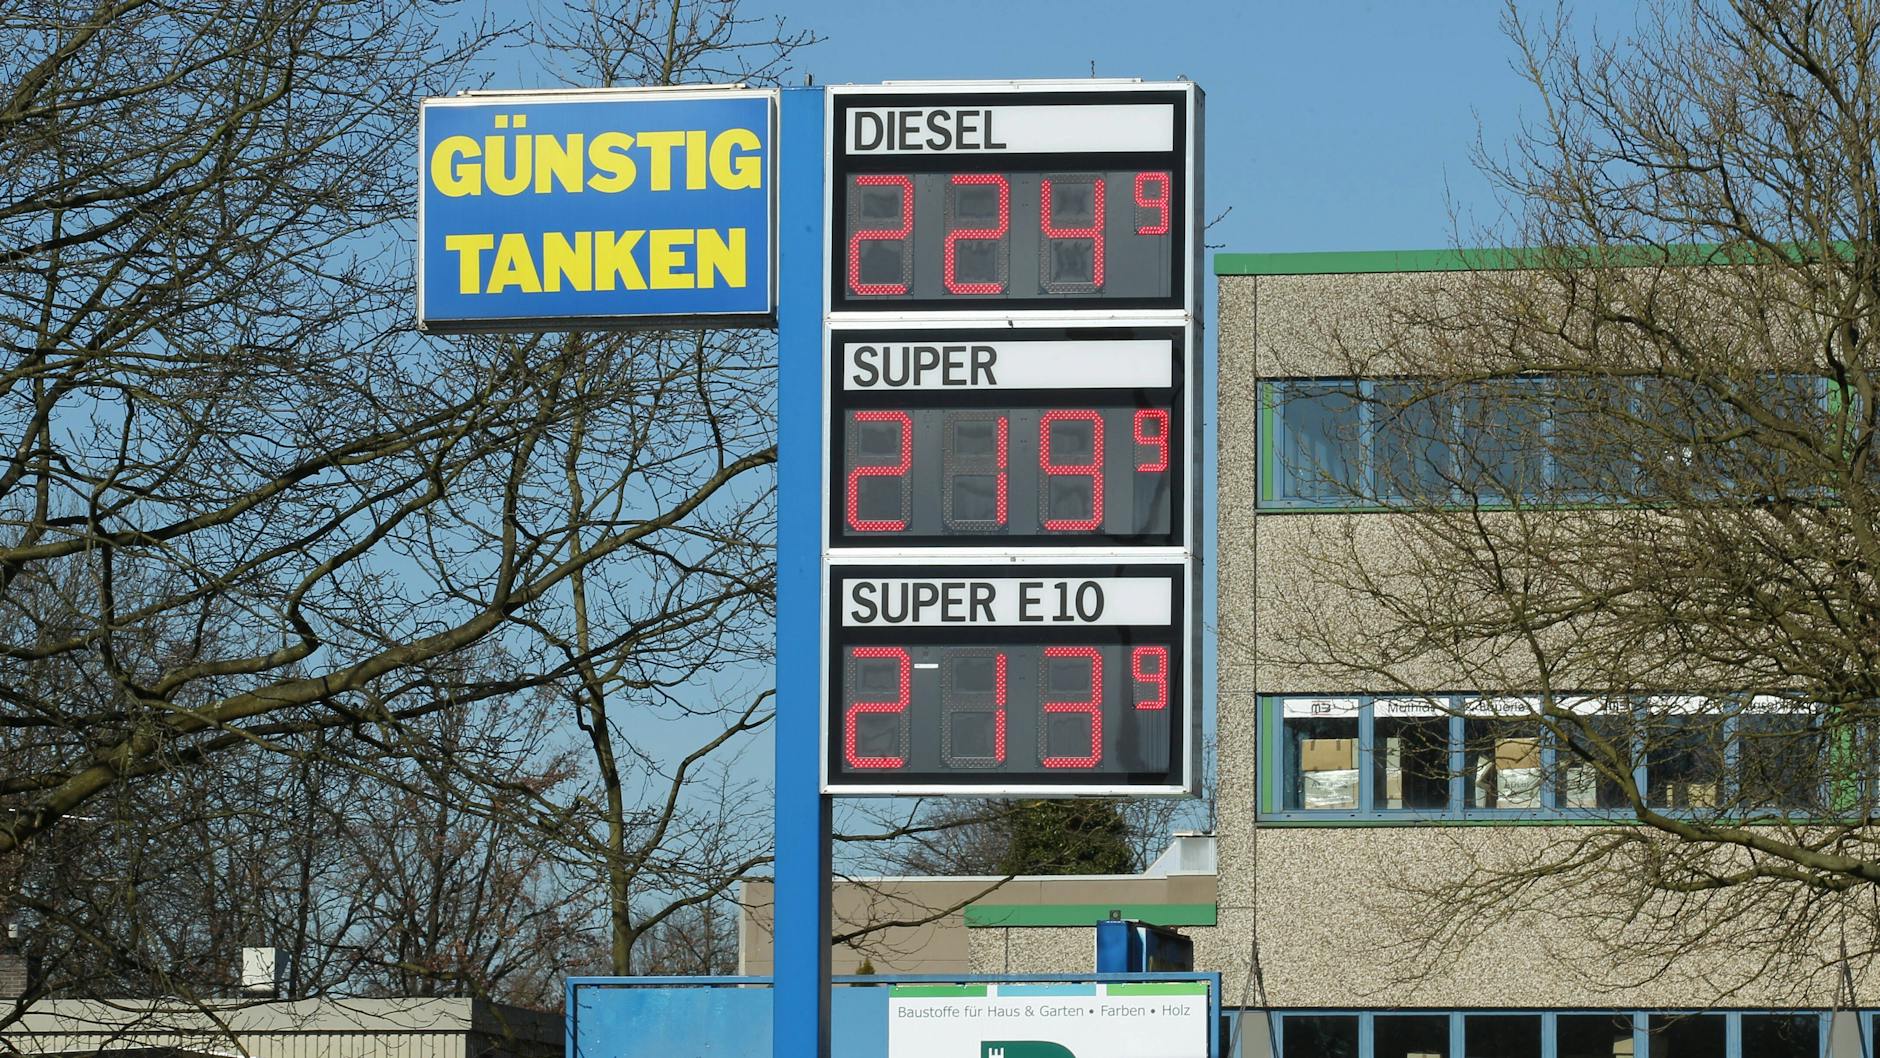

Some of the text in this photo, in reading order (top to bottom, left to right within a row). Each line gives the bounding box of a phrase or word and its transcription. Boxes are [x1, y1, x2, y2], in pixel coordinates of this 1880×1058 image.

[854, 108, 1006, 151] DIESEL
[430, 114, 762, 198] GÜNSTIG
[445, 226, 747, 295] TANKEN
[852, 345, 998, 388] SUPER
[850, 580, 1106, 624] SUPER E10
[897, 1004, 1191, 1018] Baustoffe für Haus & Garten Farben Holz
